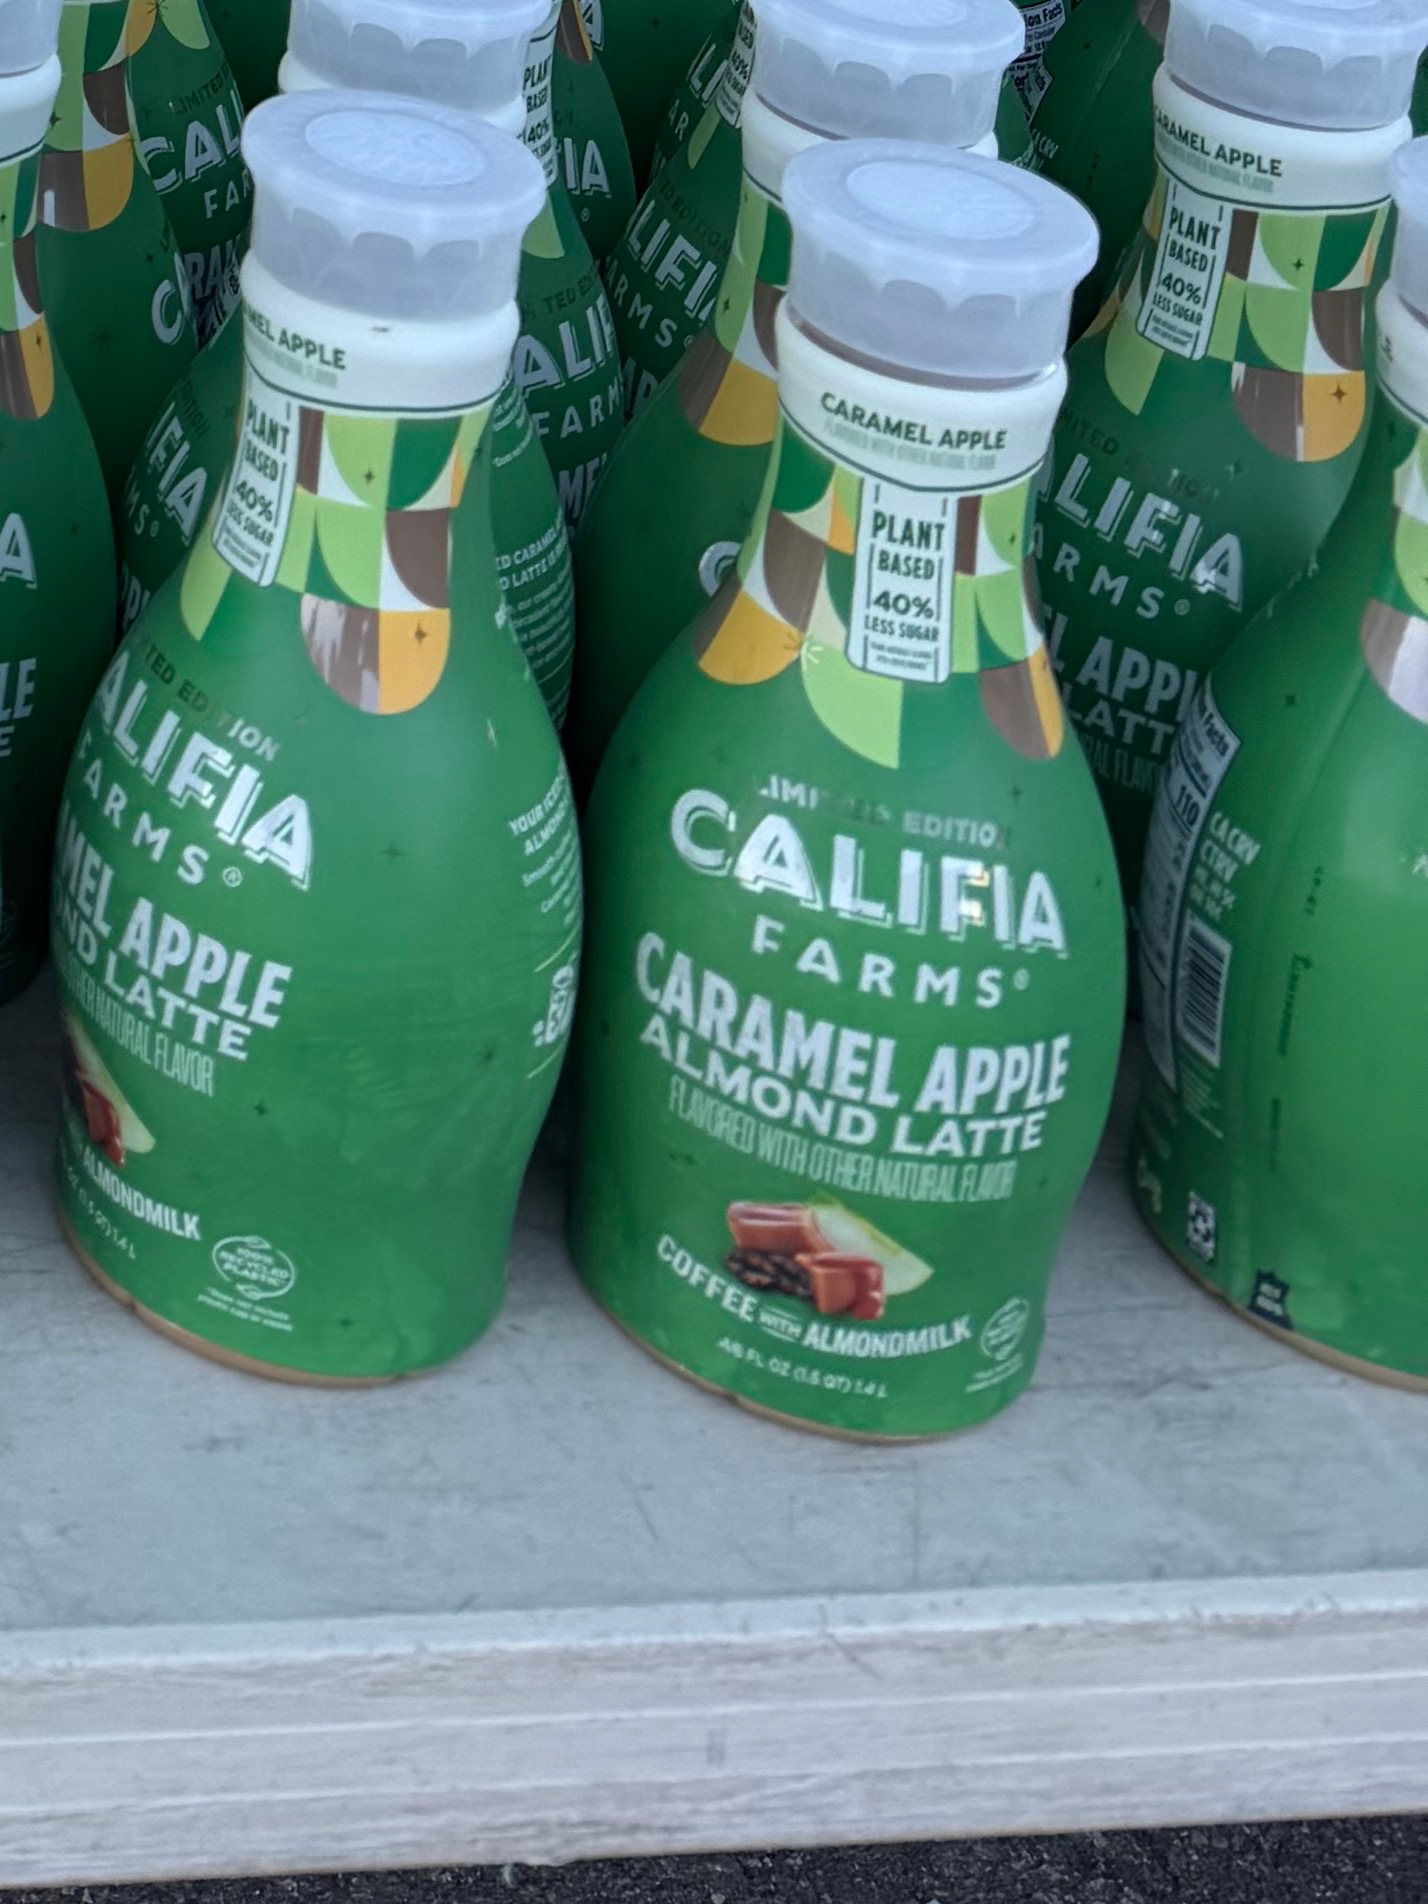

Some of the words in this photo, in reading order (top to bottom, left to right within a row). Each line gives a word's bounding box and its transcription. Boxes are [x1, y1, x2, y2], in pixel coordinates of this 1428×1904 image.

[1215, 144, 1283, 177] APPLE
[1169, 205, 1221, 250] PLANT
[1168, 239, 1209, 272] BASED
[1152, 292, 1172, 314] LESS
[1172, 302, 1203, 327] SUGAR
[1161, 272, 1202, 306] 40%
[278, 328, 347, 370] APPLE
[246, 400, 290, 454] PLANT
[821, 392, 932, 445] CARAMEL
[938, 428, 1007, 450] APPLE
[245, 440, 279, 482] BASED
[235, 479, 273, 522] 40%
[872, 510, 946, 552] PLANT
[1053, 453, 1243, 613] LIFIA
[877, 550, 935, 580] BASED
[865, 614, 894, 635] LESS
[898, 618, 939, 642] SUGAR
[873, 590, 934, 619] 40%
[97, 649, 311, 892] ALIFIA
[671, 788, 1069, 960] CALIFIA
[118, 896, 293, 1030] APPLE
[752, 914, 1004, 1010] FARMS
[103, 949, 253, 1062] LATTE
[635, 930, 901, 1109] CARAMEL
[914, 1033, 1070, 1116] APPLE
[154, 1031, 214, 1098] FLAVOR
[640, 1012, 877, 1146] ALMOND
[890, 1109, 1047, 1159] LATTE
[669, 1074, 755, 1155] FLAVORED
[756, 1121, 808, 1179] WITH
[808, 1140, 877, 1194] OTHER
[877, 1155, 960, 1204] NATURAL
[82, 1144, 202, 1242] ALMONDMILK
[656, 1234, 758, 1323] COFFEE
[758, 1308, 801, 1339] WITH
[802, 1315, 973, 1359] ALMONDMILK
[746, 1348, 765, 1369] FL
[768, 1356, 791, 1378] OZ
